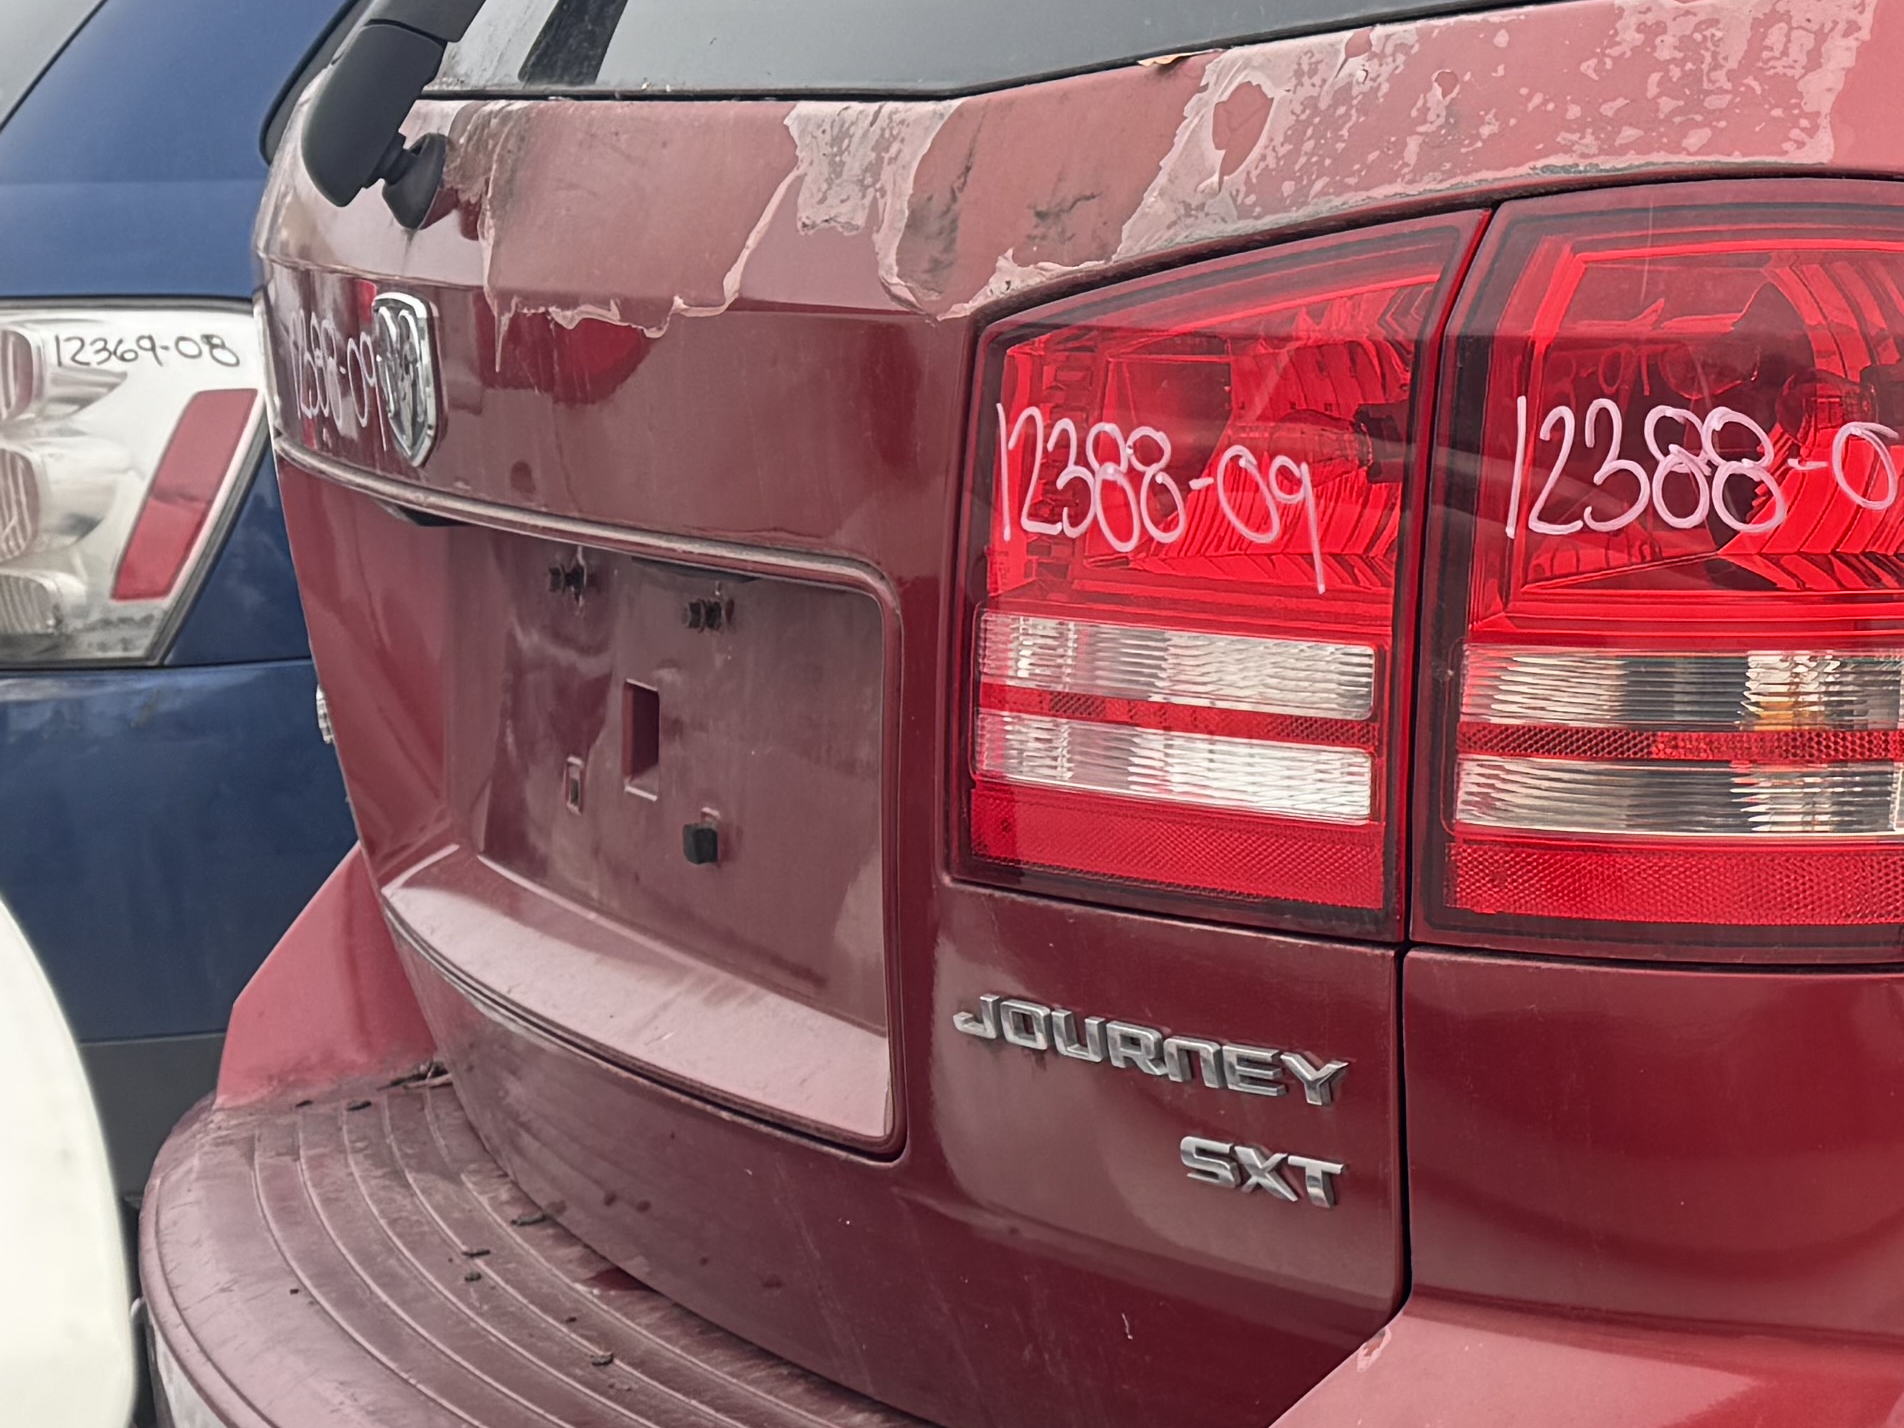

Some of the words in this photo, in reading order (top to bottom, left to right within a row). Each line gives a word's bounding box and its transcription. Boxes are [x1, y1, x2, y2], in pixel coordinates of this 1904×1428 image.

[54, 333, 241, 368] 12369-08
[996, 402, 1327, 594] 12388-09
[952, 993, 1351, 1107] JOURNEY
[1179, 1135, 1346, 1209] SXT
